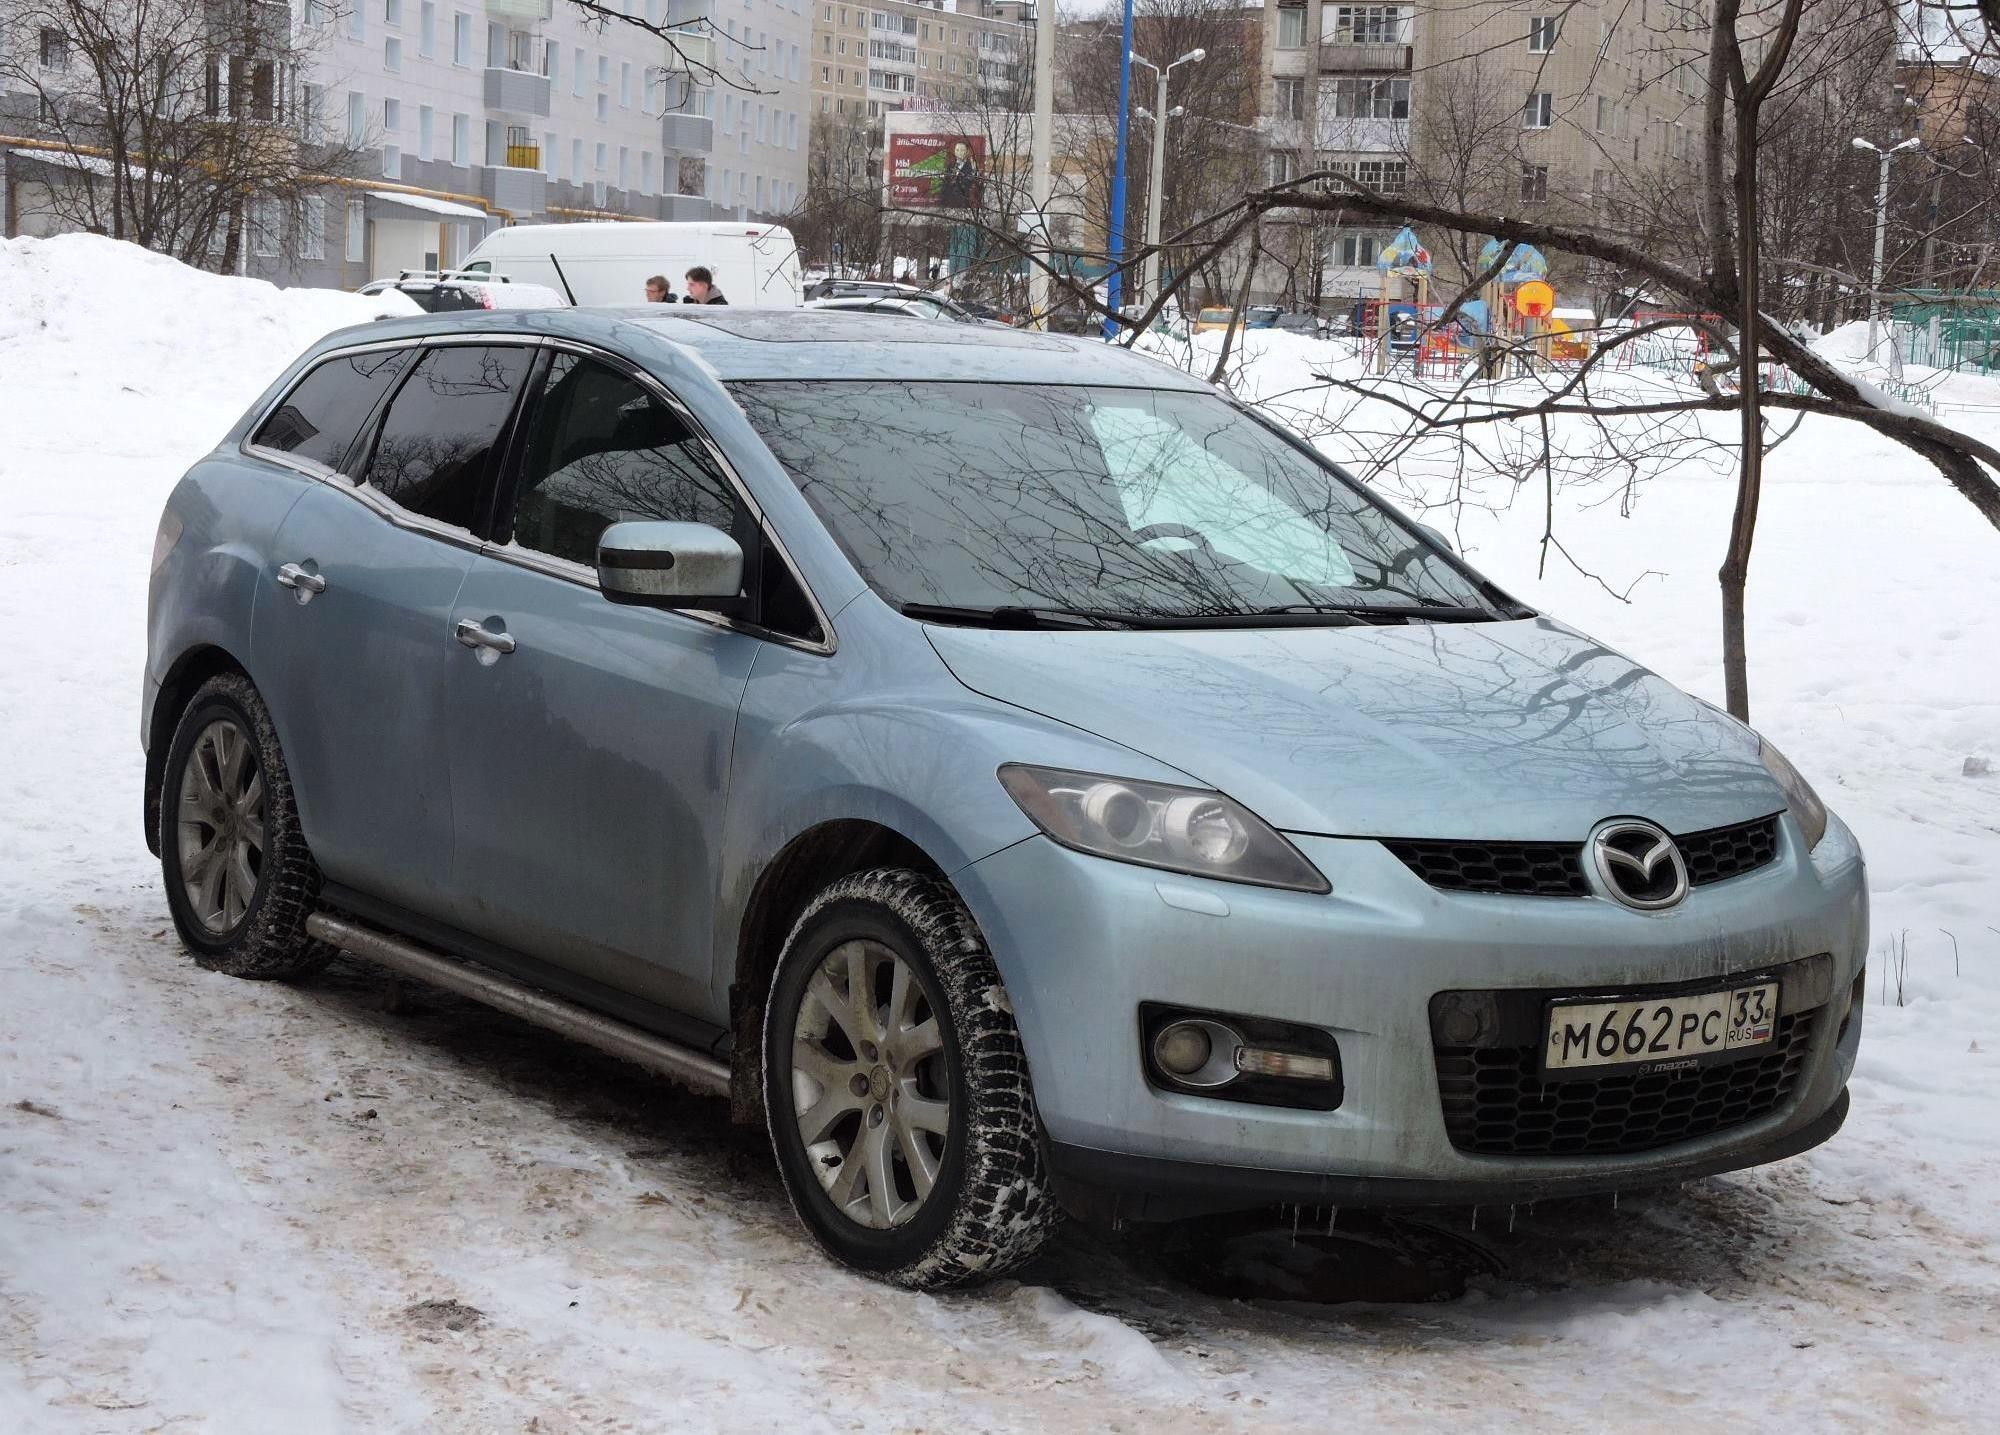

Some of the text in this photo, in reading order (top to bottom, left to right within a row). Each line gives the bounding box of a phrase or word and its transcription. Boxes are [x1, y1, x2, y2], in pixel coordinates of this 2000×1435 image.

[895, 159, 910, 168] МЫ
[1733, 989, 1766, 1028] 33
[1728, 1027, 1751, 1043] RUS
